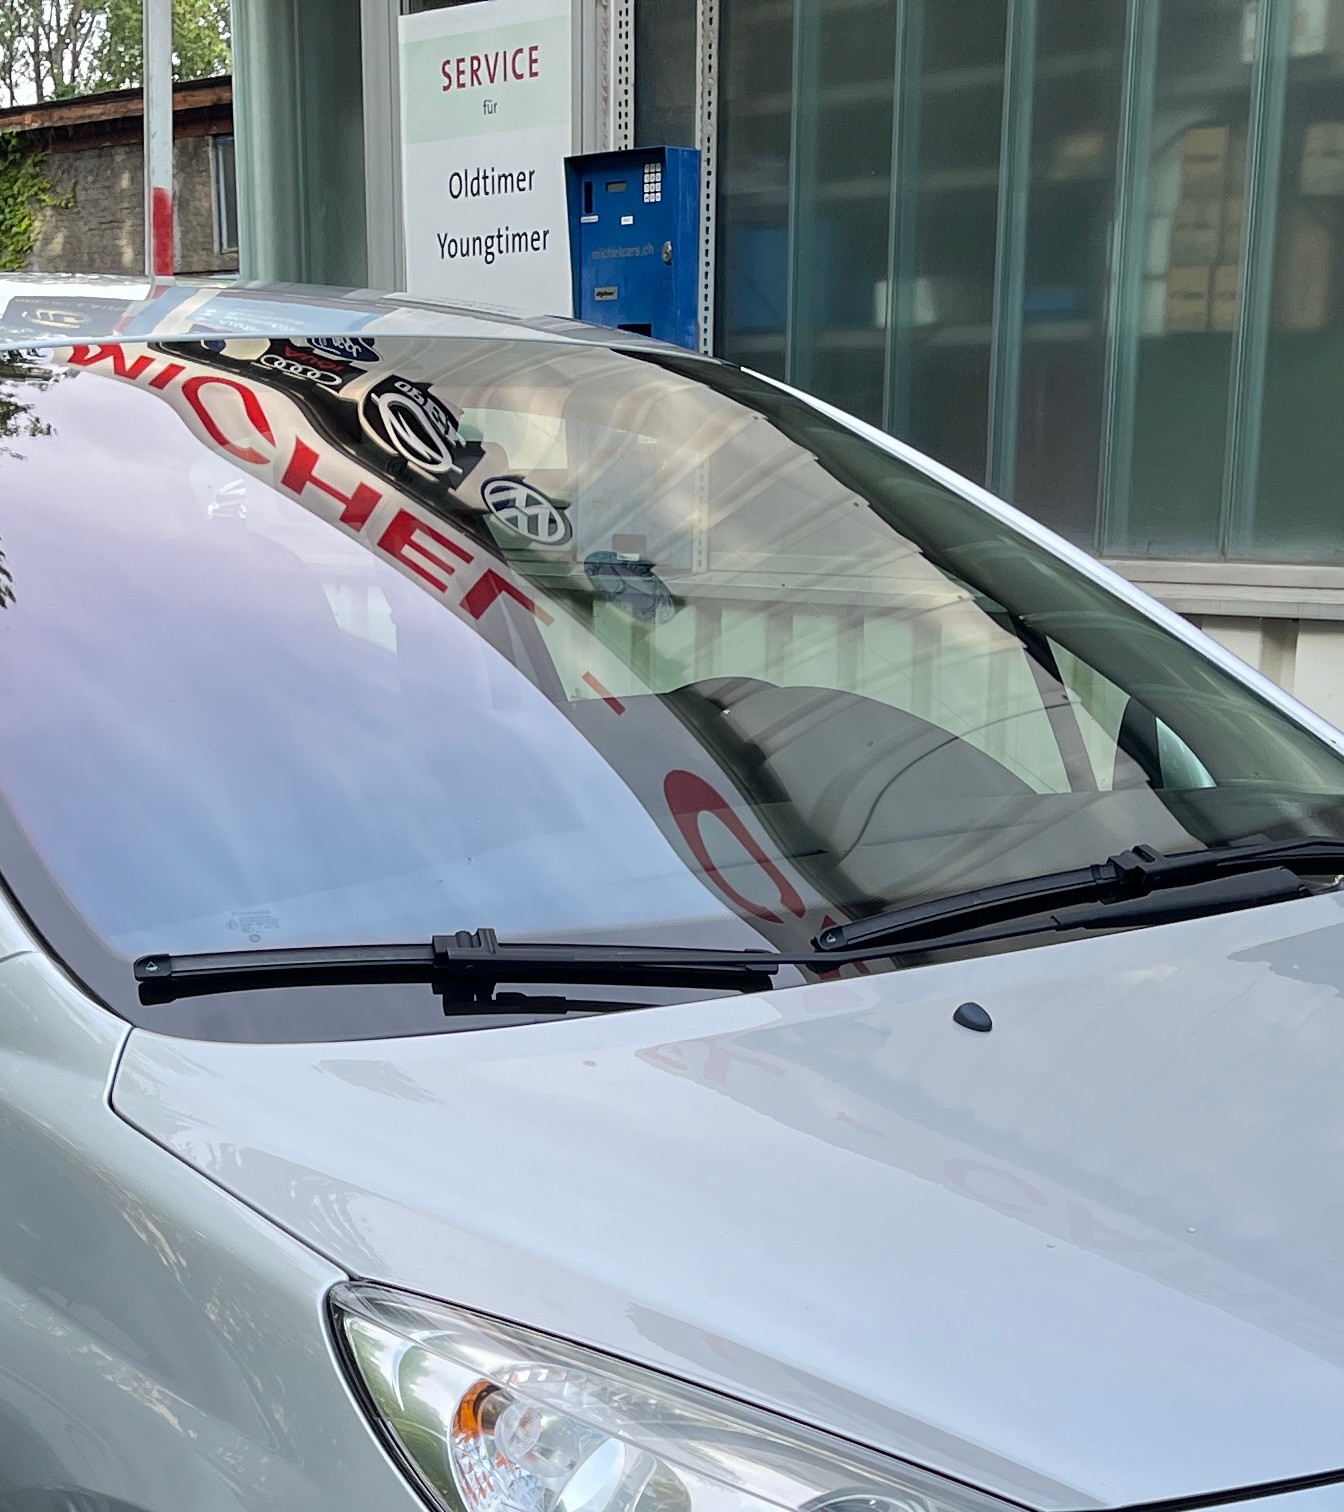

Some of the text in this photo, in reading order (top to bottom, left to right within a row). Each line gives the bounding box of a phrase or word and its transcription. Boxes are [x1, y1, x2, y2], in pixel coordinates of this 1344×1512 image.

[441, 44, 540, 92] SERVICE
[483, 98, 498, 116] für
[449, 167, 536, 200] Oldtimer
[437, 227, 550, 265] Youngtimer
[591, 243, 655, 260] michelcars.ch
